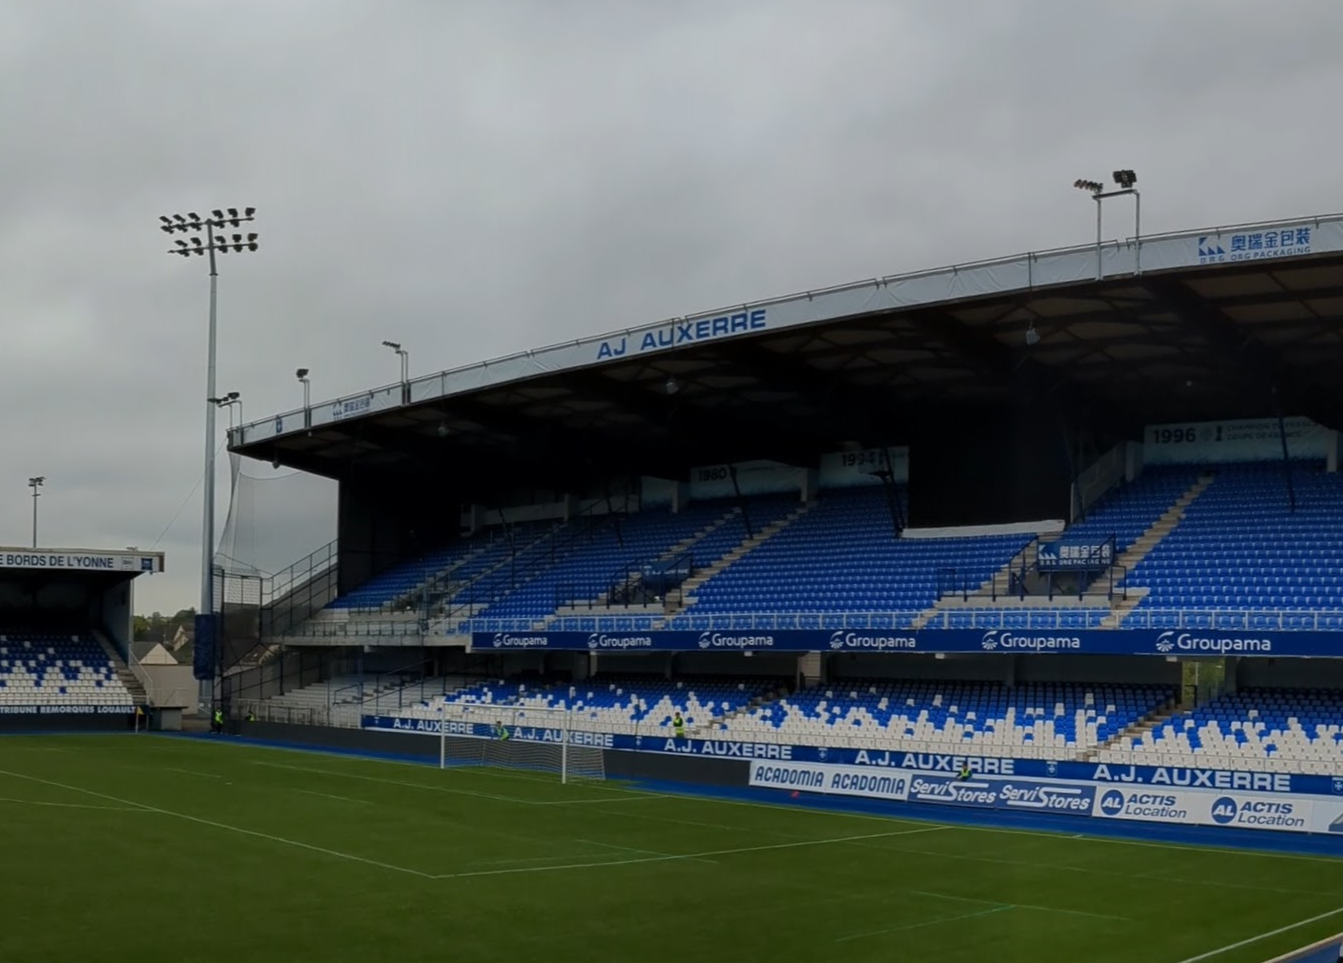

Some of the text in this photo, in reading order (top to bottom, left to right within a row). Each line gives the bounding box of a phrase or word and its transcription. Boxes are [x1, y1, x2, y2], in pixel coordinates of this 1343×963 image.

[1230, 227, 1311, 252] 奥瑞金包装
[1230, 252, 1251, 262] ORG
[1254, 246, 1311, 258] PACKAGING
[596, 310, 766, 360] AJ AUXERRE
[1153, 428, 1196, 444] 1996
[697, 467, 727, 483] 1980
[7, 554, 46, 566] BORDS
[50, 555, 65, 567] DE
[68, 556, 114, 569] L'YONNE
[503, 634, 548, 647] Groupama
[599, 634, 652, 648] Groupama
[712, 633, 774, 649] Groupama
[845, 632, 916, 650] Groupama
[1000, 632, 1080, 651] Groupama
[1177, 633, 1271, 654] Groupama
[394, 718, 474, 734] A.J. AUXERRE
[514, 728, 539, 740] A.J.
[664, 739, 792, 759] A.J. AUXERRE
[854, 750, 1015, 774] A.J. AUXERRE
[754, 766, 825, 788] ACADOMIA
[830, 773, 906, 795] ACADOMIA
[1092, 764, 1291, 791] A.J. AUXERRE
[1101, 797, 1123, 809] AL
[1126, 794, 1177, 807] ACTIS
[1238, 801, 1294, 815] ACTIS
[1124, 804, 1187, 820] Location
[1212, 804, 1235, 817] AL
[1237, 812, 1306, 828] Location
